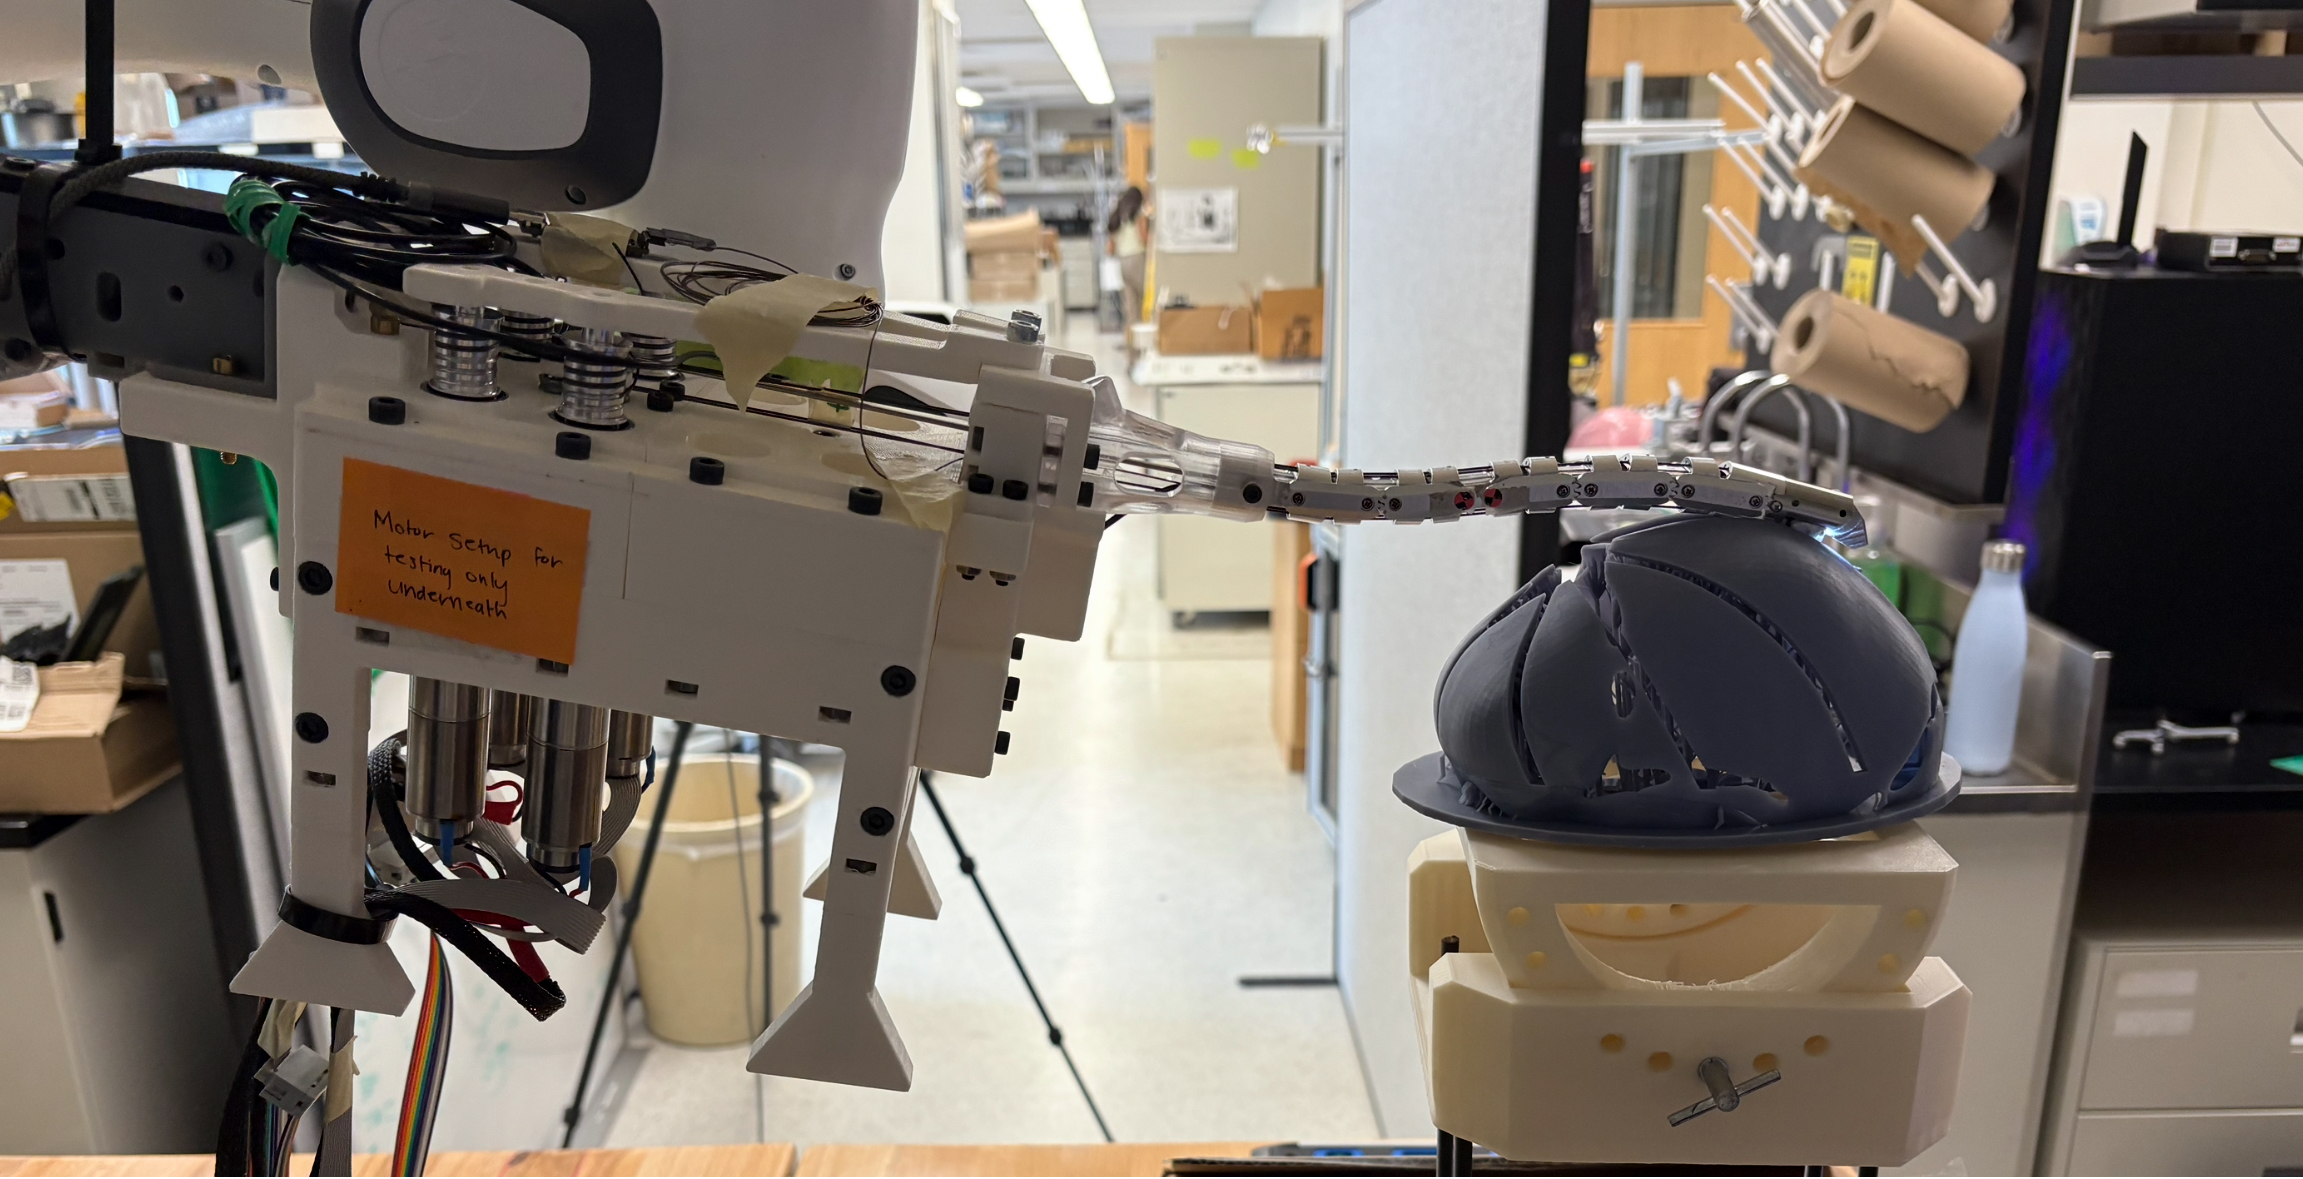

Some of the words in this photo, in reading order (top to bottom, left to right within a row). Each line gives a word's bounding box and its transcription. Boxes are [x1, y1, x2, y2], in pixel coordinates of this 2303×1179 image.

[373, 509, 434, 538] Motor
[384, 545, 452, 590] testing
[465, 571, 508, 607] only
